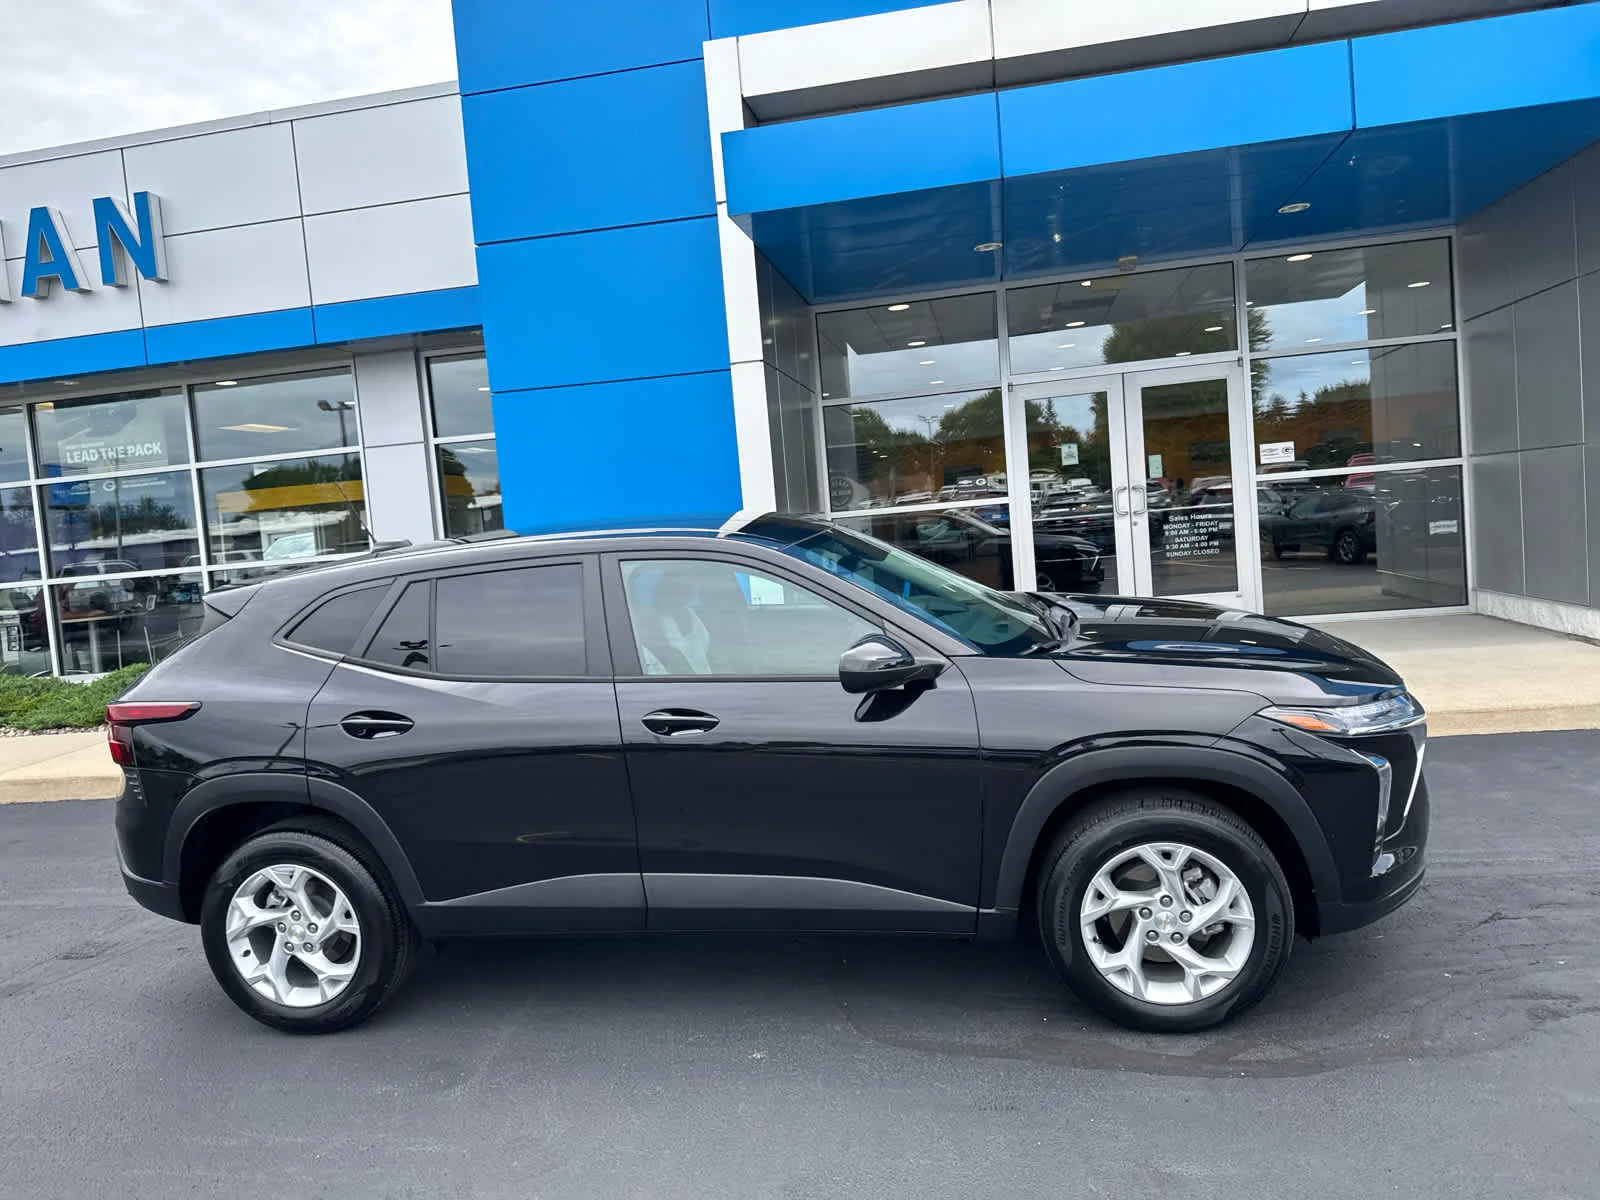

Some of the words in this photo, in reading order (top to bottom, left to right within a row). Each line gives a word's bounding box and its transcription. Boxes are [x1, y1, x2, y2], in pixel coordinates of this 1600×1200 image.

[0, 191, 168, 303] AN
[66, 448, 98, 464] LEAD
[99, 446, 126, 460] THE
[127, 442, 162, 457] PACK
[1174, 535, 1208, 543] SATURDAY
